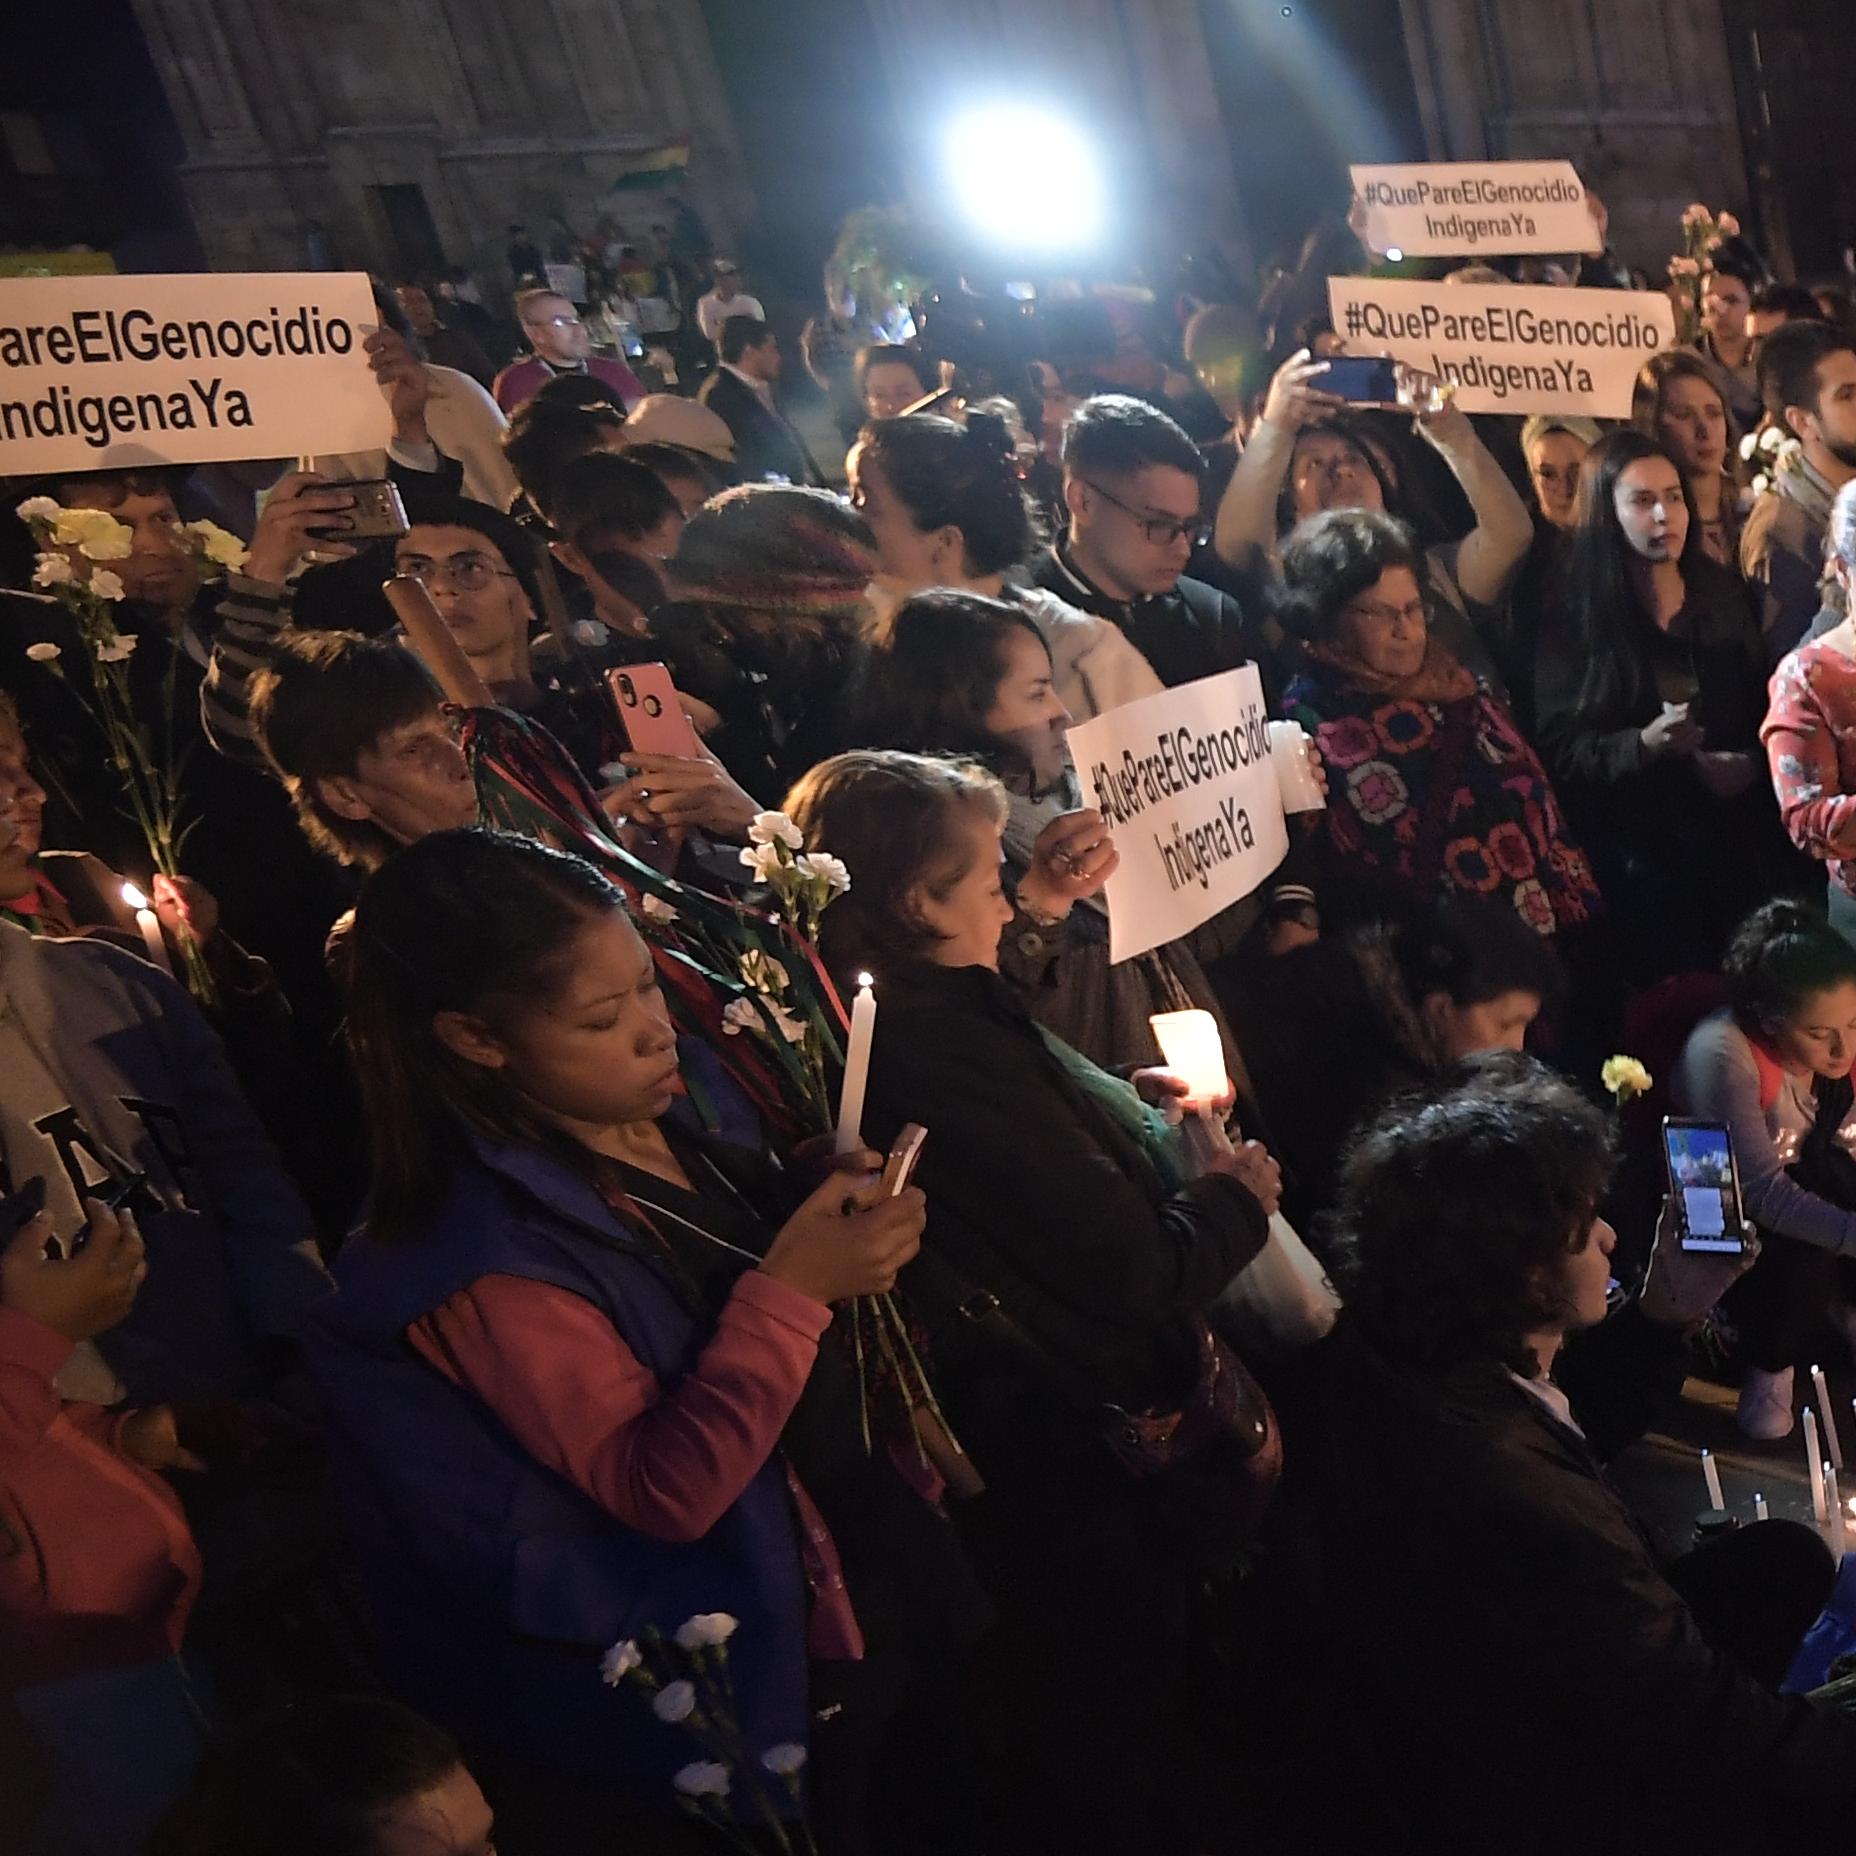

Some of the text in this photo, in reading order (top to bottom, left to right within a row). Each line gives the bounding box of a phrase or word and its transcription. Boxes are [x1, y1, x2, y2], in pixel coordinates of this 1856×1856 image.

[1365, 178, 1580, 206] #QuePareElGenocidio
[1426, 213, 1537, 243] IndigenaYa
[1345, 302, 1659, 349] #QuePareElGenocidio
[1154, 797, 1255, 891] IndigenaYa
